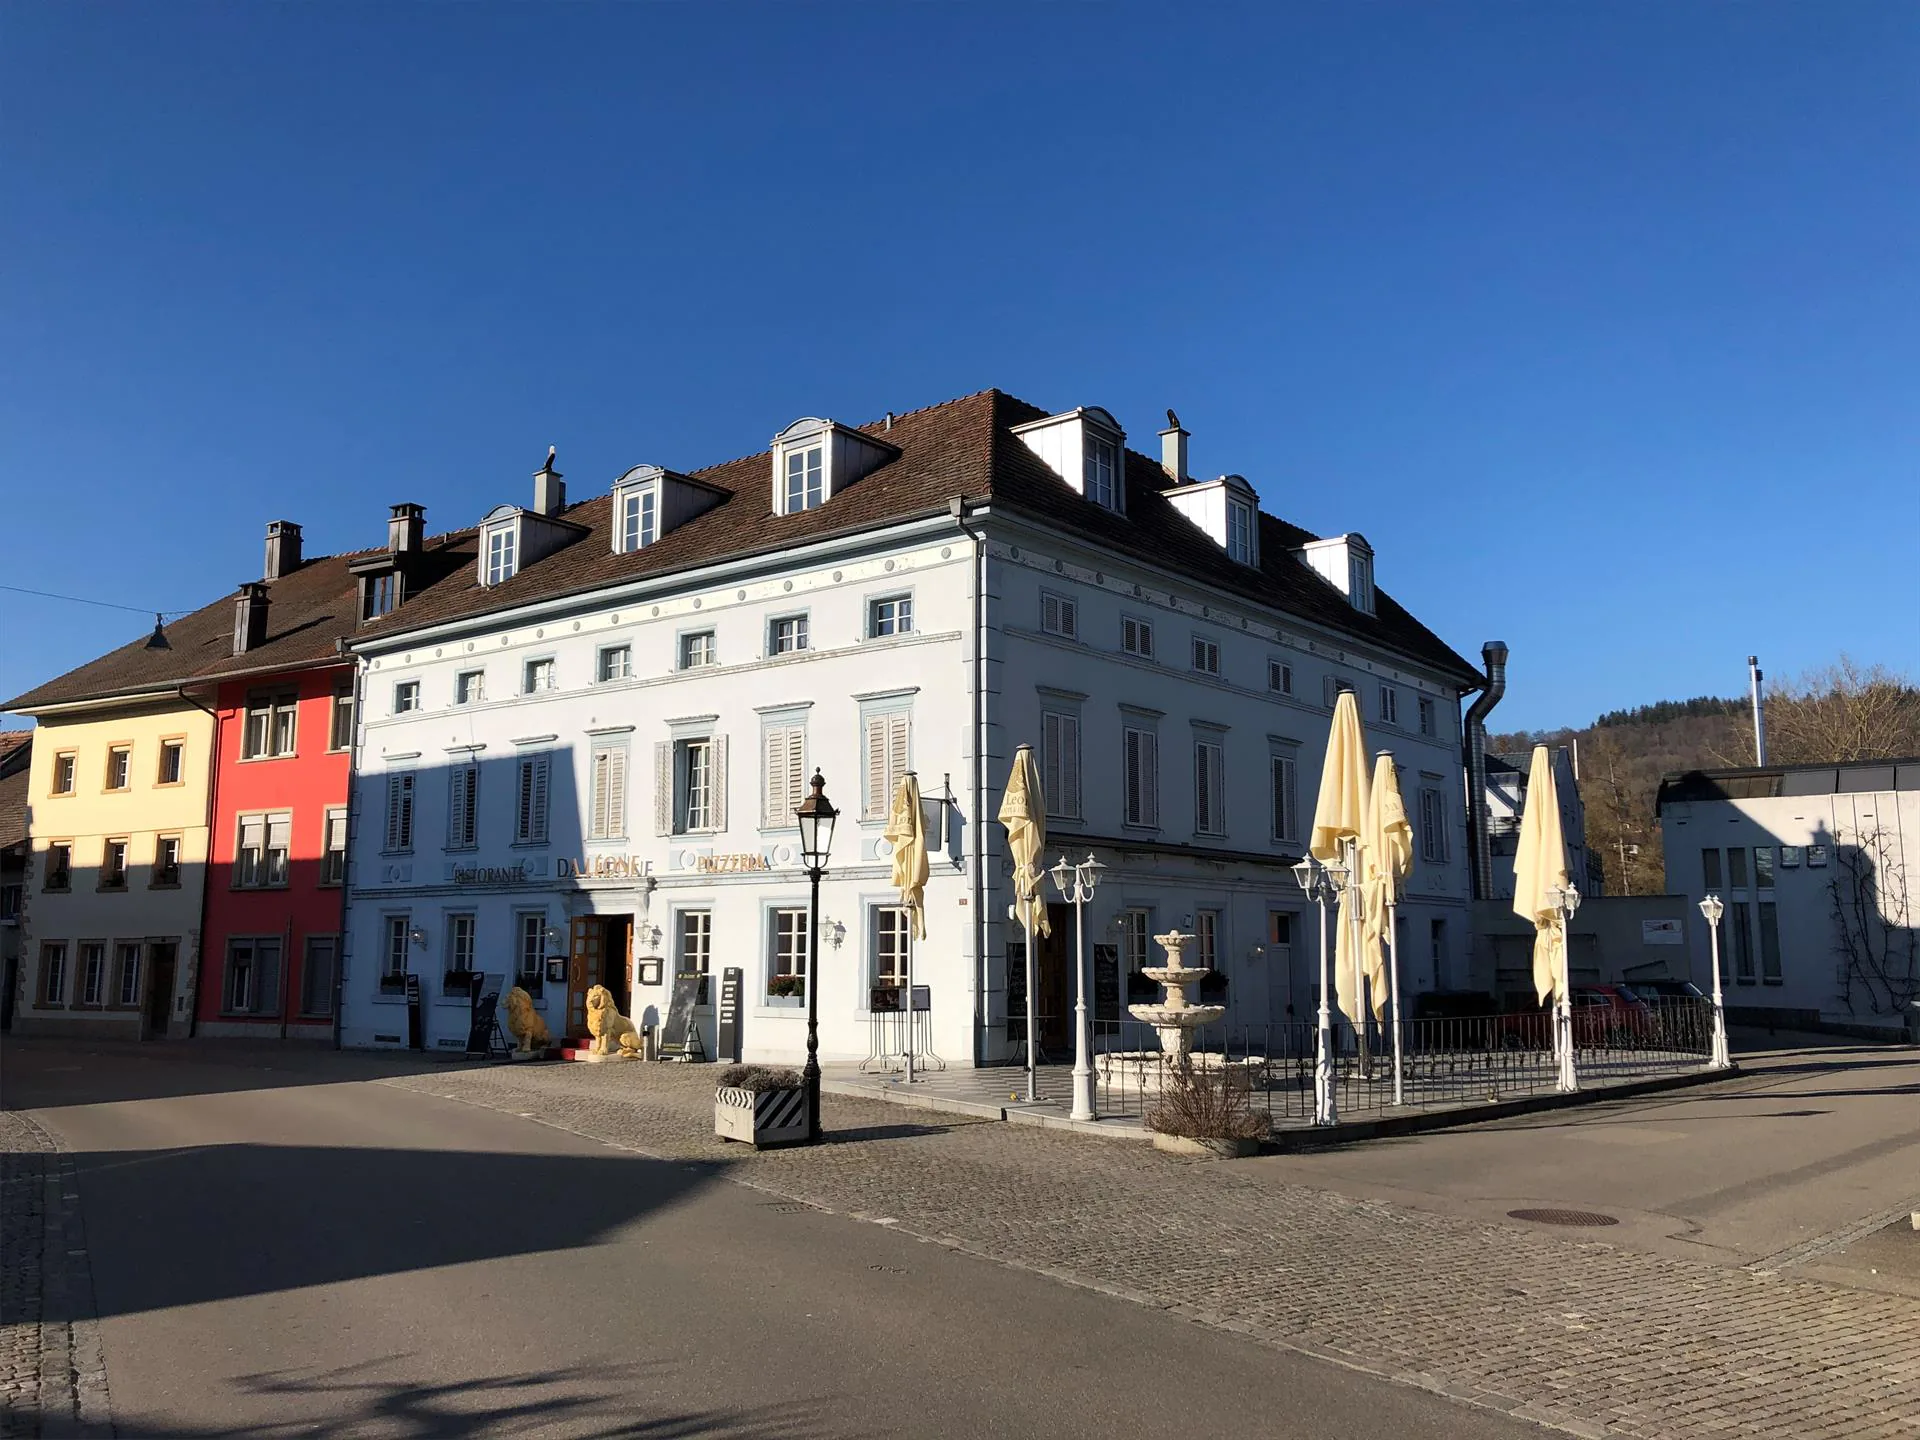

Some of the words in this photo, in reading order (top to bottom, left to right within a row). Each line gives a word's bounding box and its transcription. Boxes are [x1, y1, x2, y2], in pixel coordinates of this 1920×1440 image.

[557, 858, 581, 877] DA
[584, 855, 641, 878] LEONE
[697, 853, 766, 873] PIZZERIA
[455, 866, 526, 883] RISTORANTE
